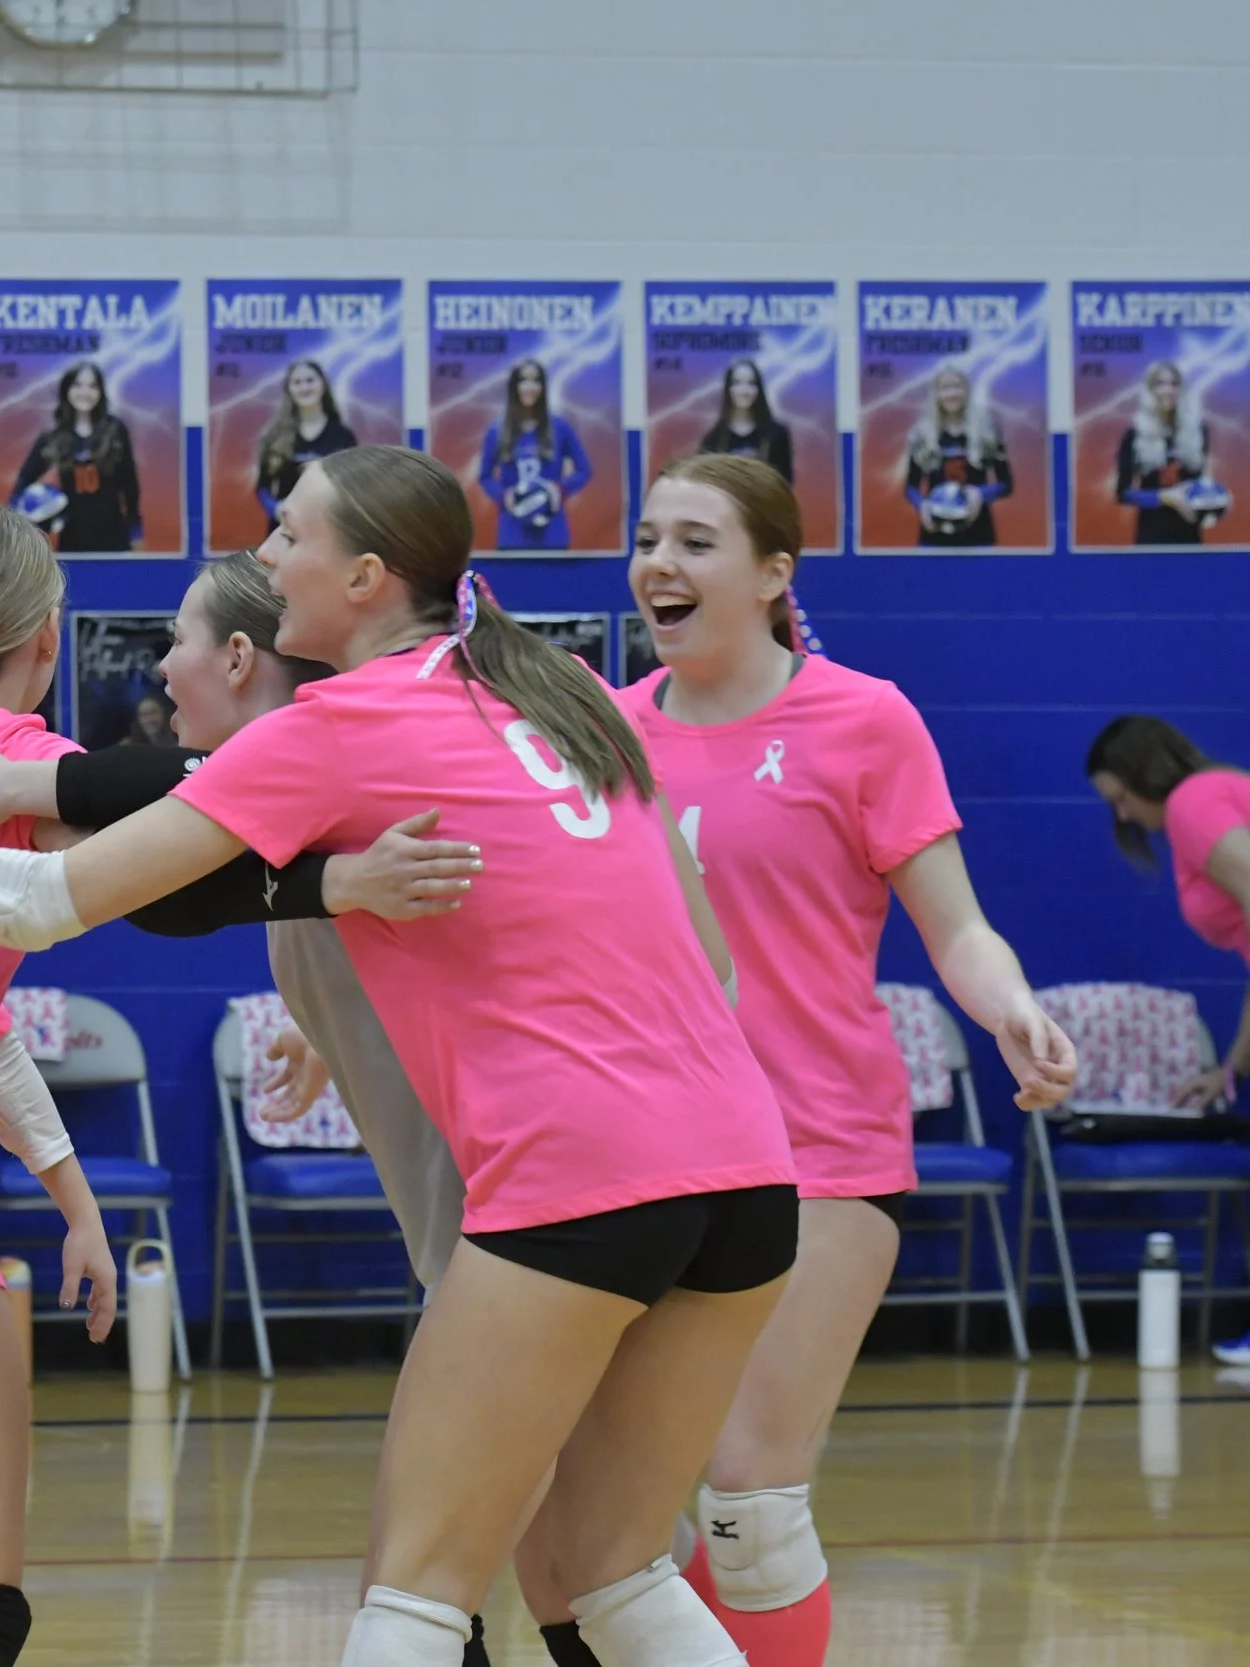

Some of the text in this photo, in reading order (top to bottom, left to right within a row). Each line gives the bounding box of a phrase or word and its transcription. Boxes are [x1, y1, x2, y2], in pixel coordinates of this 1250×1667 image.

[213, 293, 384, 329] MOILANEN
[434, 294, 595, 331] HEINONEN
[650, 294, 838, 326] KEMPPAINEN
[865, 294, 1018, 331] KERANEN
[504, 718, 612, 840] 9
